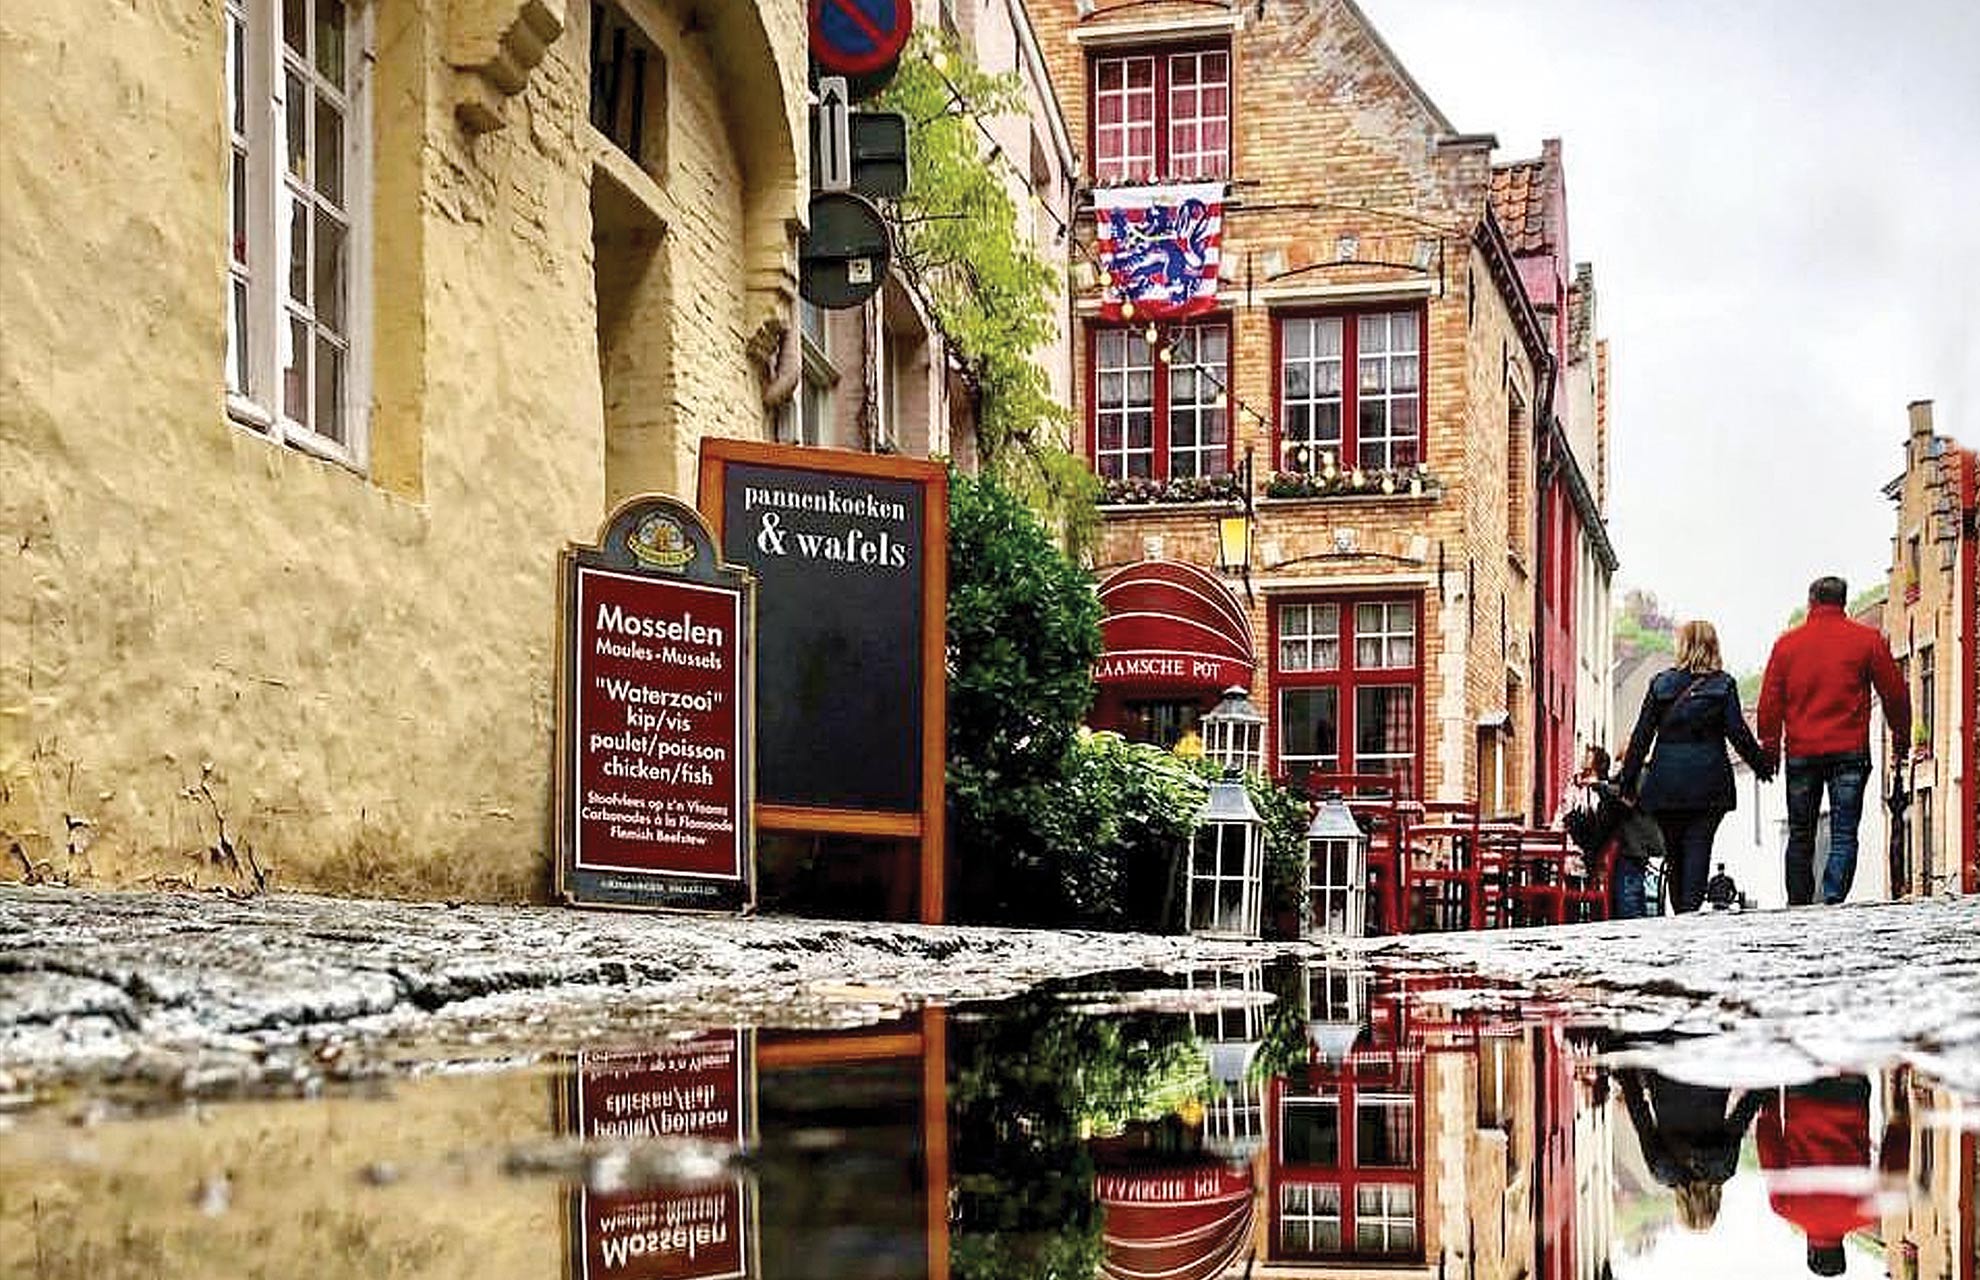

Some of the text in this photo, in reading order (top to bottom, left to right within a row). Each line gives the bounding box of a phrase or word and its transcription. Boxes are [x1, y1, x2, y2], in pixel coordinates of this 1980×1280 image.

[745, 487, 905, 521] pannenkoeken
[757, 512, 906, 567] & wafels
[596, 603, 722, 646] Mosselen
[1095, 658, 1221, 681] LAAMSCHE POT
[596, 676, 722, 711] "Waterzooi"
[627, 705, 692, 732] kip/vis
[590, 731, 725, 761] poulet/poisson
[603, 755, 714, 785] chicken/fish
